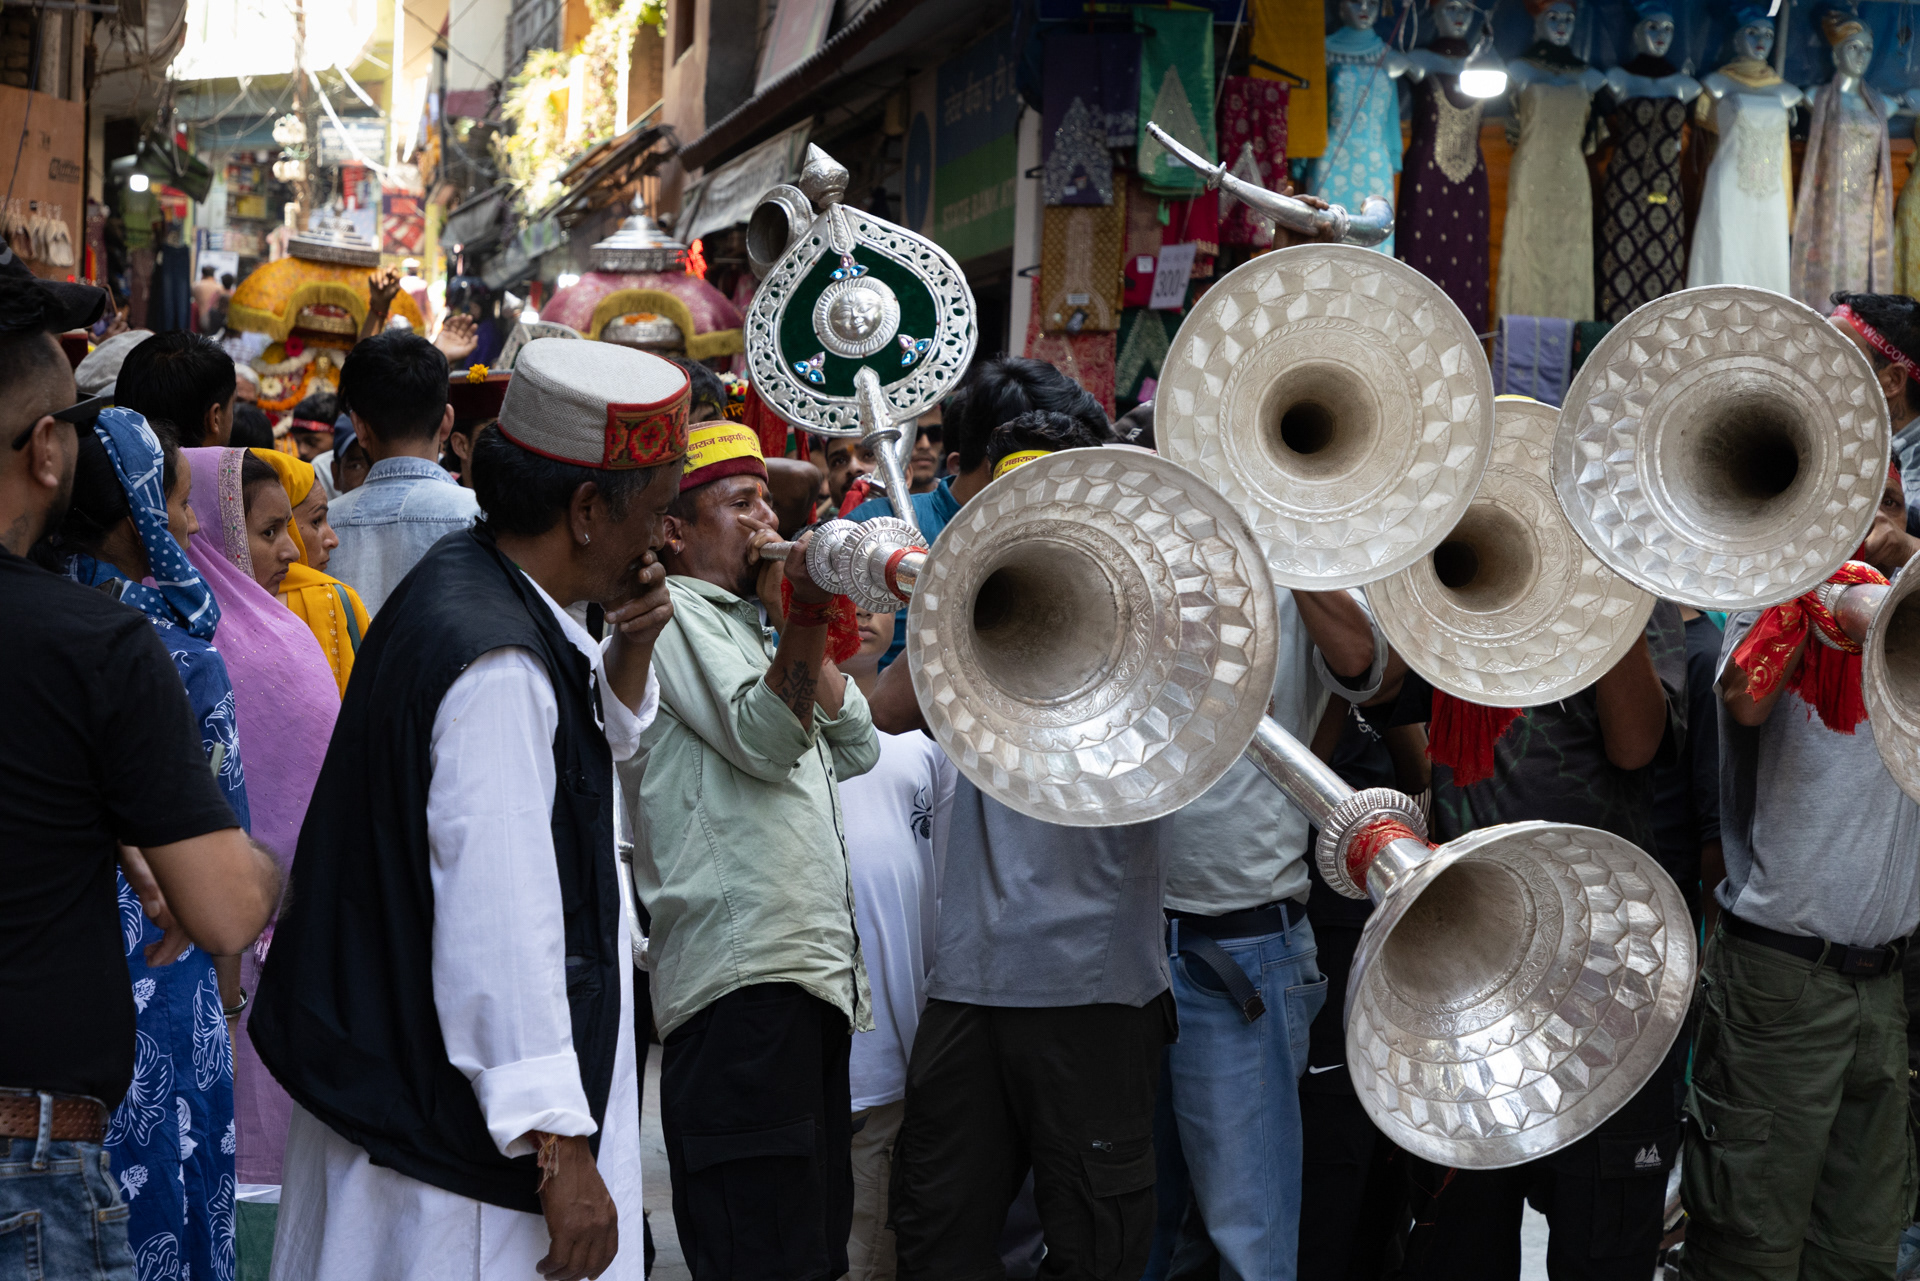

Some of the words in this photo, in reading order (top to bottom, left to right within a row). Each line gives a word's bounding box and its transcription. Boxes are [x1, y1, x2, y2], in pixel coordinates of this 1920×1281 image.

[943, 197, 970, 232] STATE
[971, 184, 999, 221] BANK
[1863, 324, 1915, 373] WELCOME
